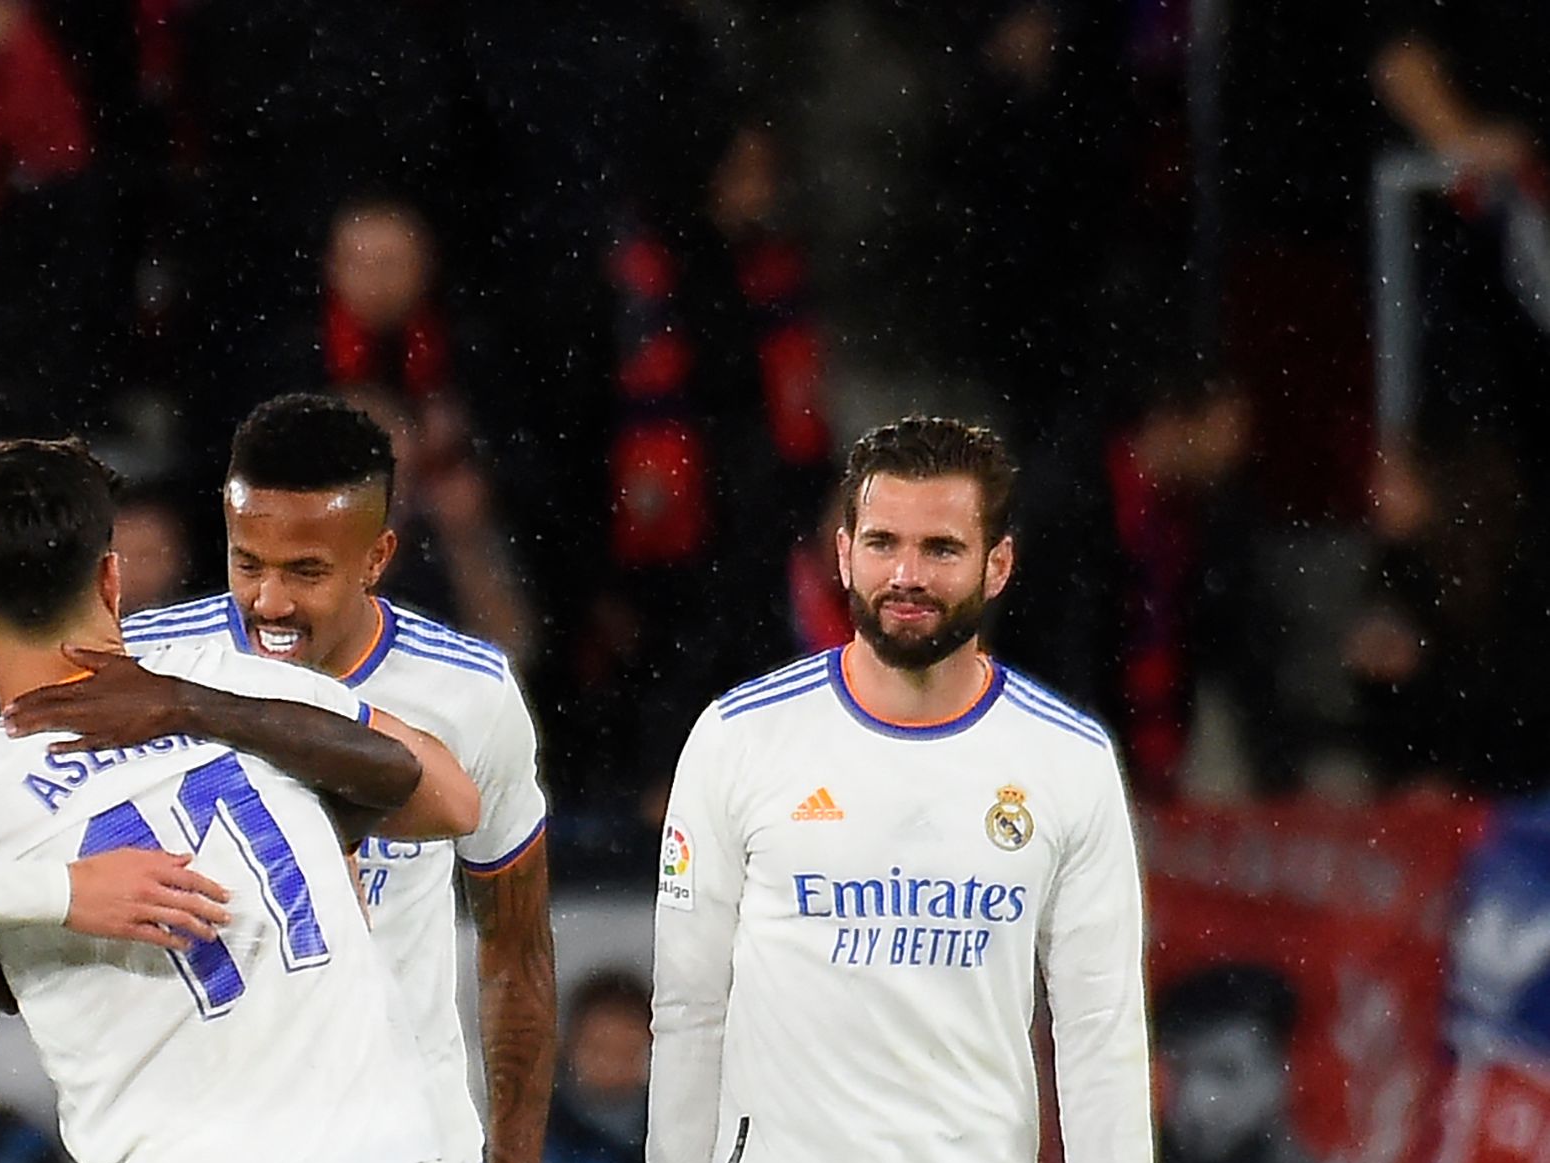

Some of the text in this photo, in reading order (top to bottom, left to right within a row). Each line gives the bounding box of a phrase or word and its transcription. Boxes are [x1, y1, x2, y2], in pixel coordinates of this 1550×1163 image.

[659, 881, 690, 899] Liga
[793, 867, 1027, 923] Emirates
[831, 927, 990, 967] FLY BETTER
